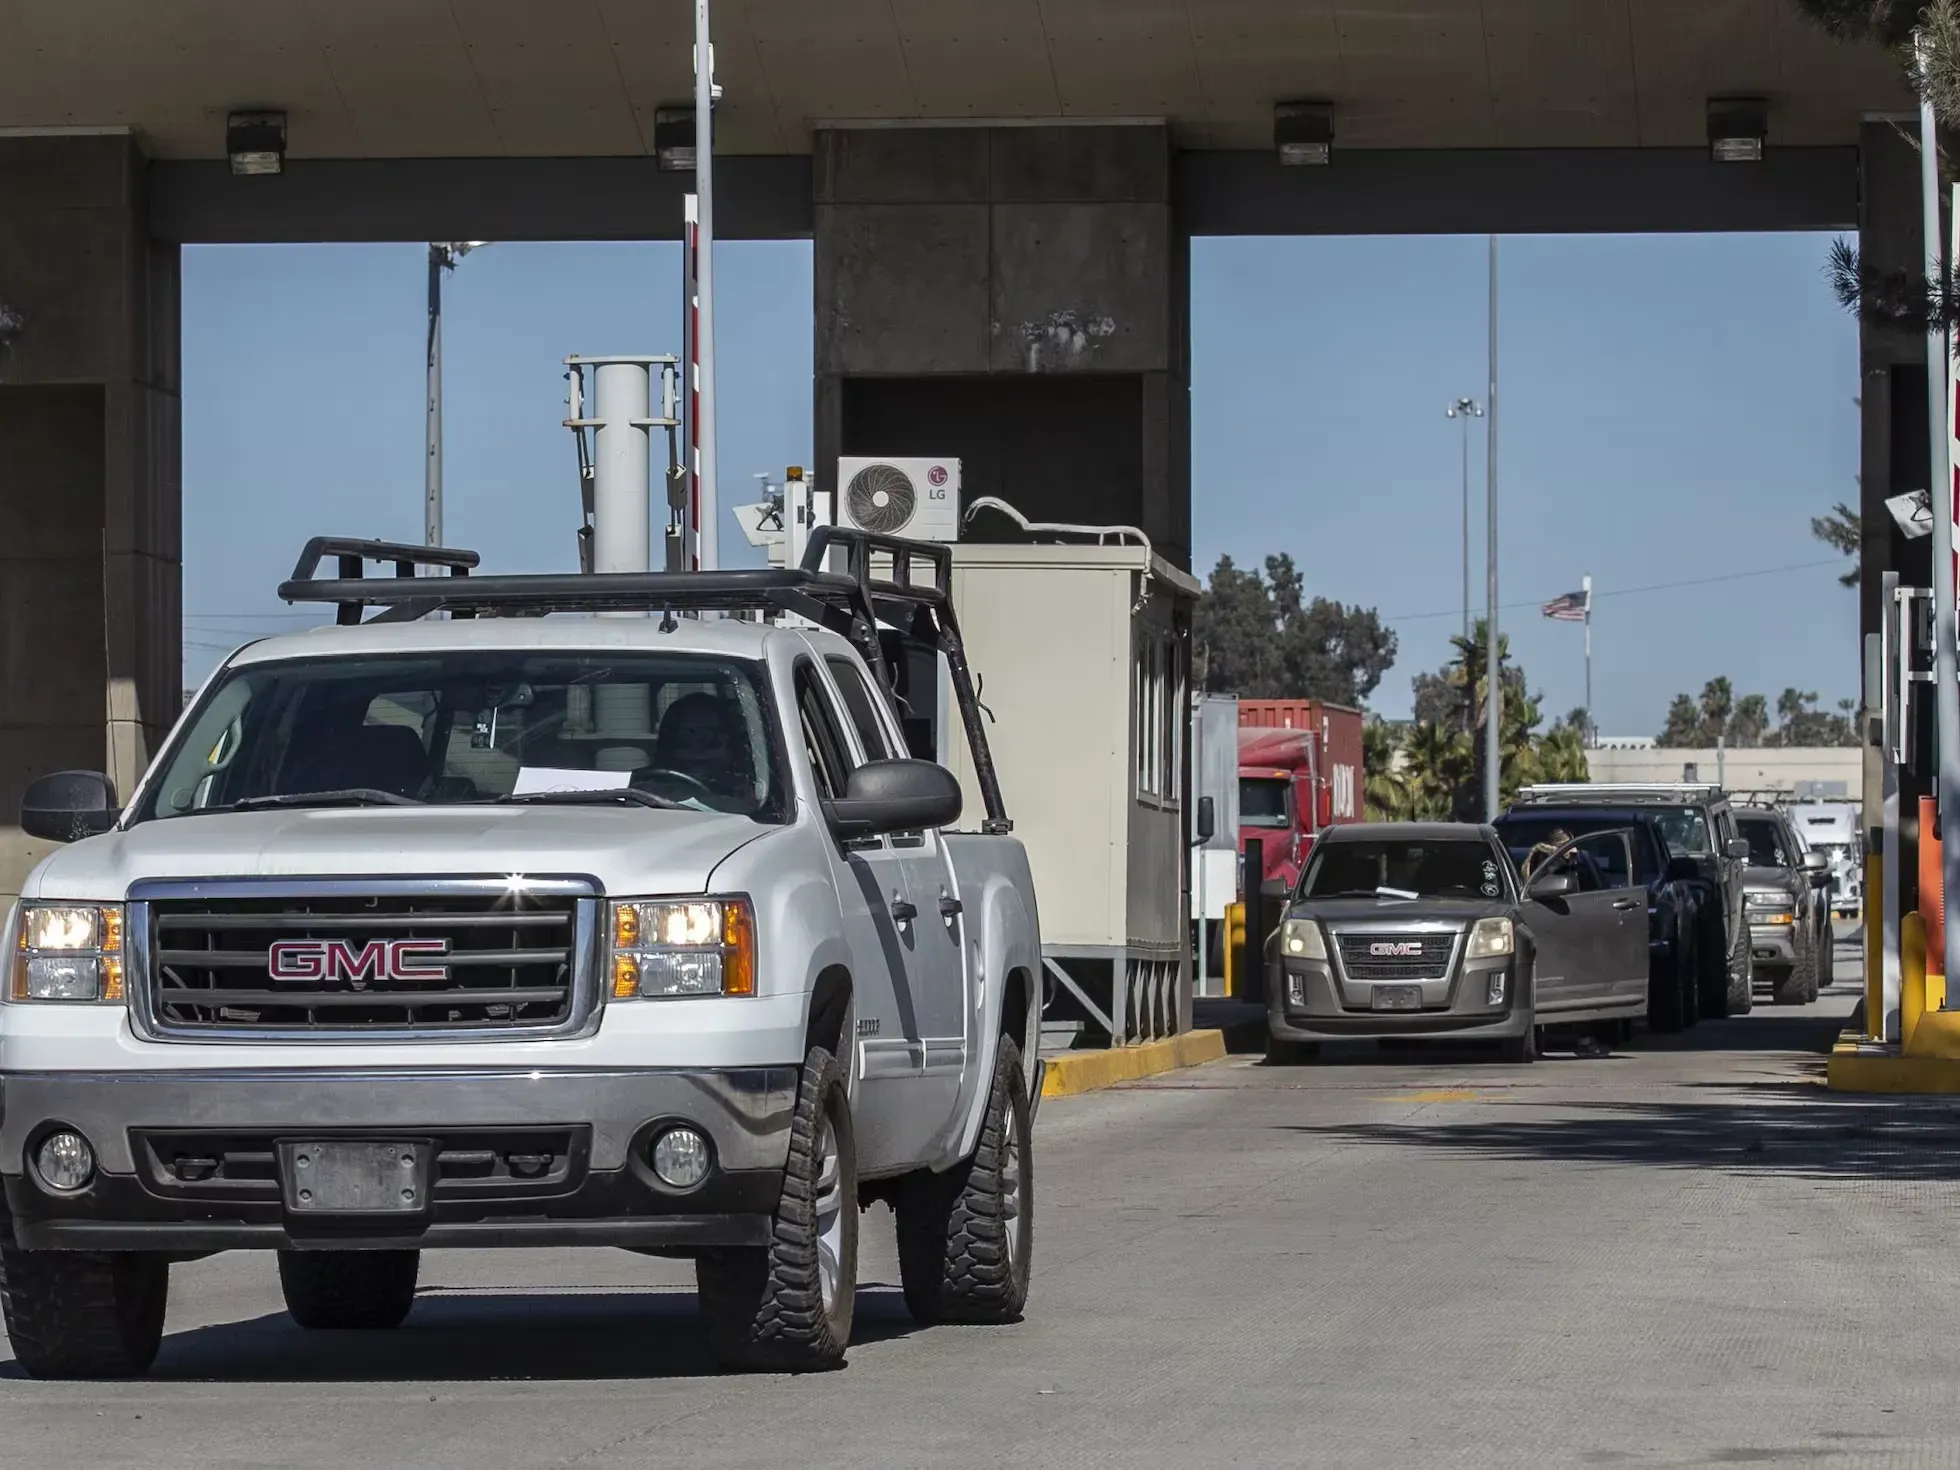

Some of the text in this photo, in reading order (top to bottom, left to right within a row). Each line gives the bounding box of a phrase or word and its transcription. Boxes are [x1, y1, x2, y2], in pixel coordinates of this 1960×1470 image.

[929, 489, 946, 500] LG
[1370, 943, 1422, 956] GMC
[269, 939, 449, 981] GMC
